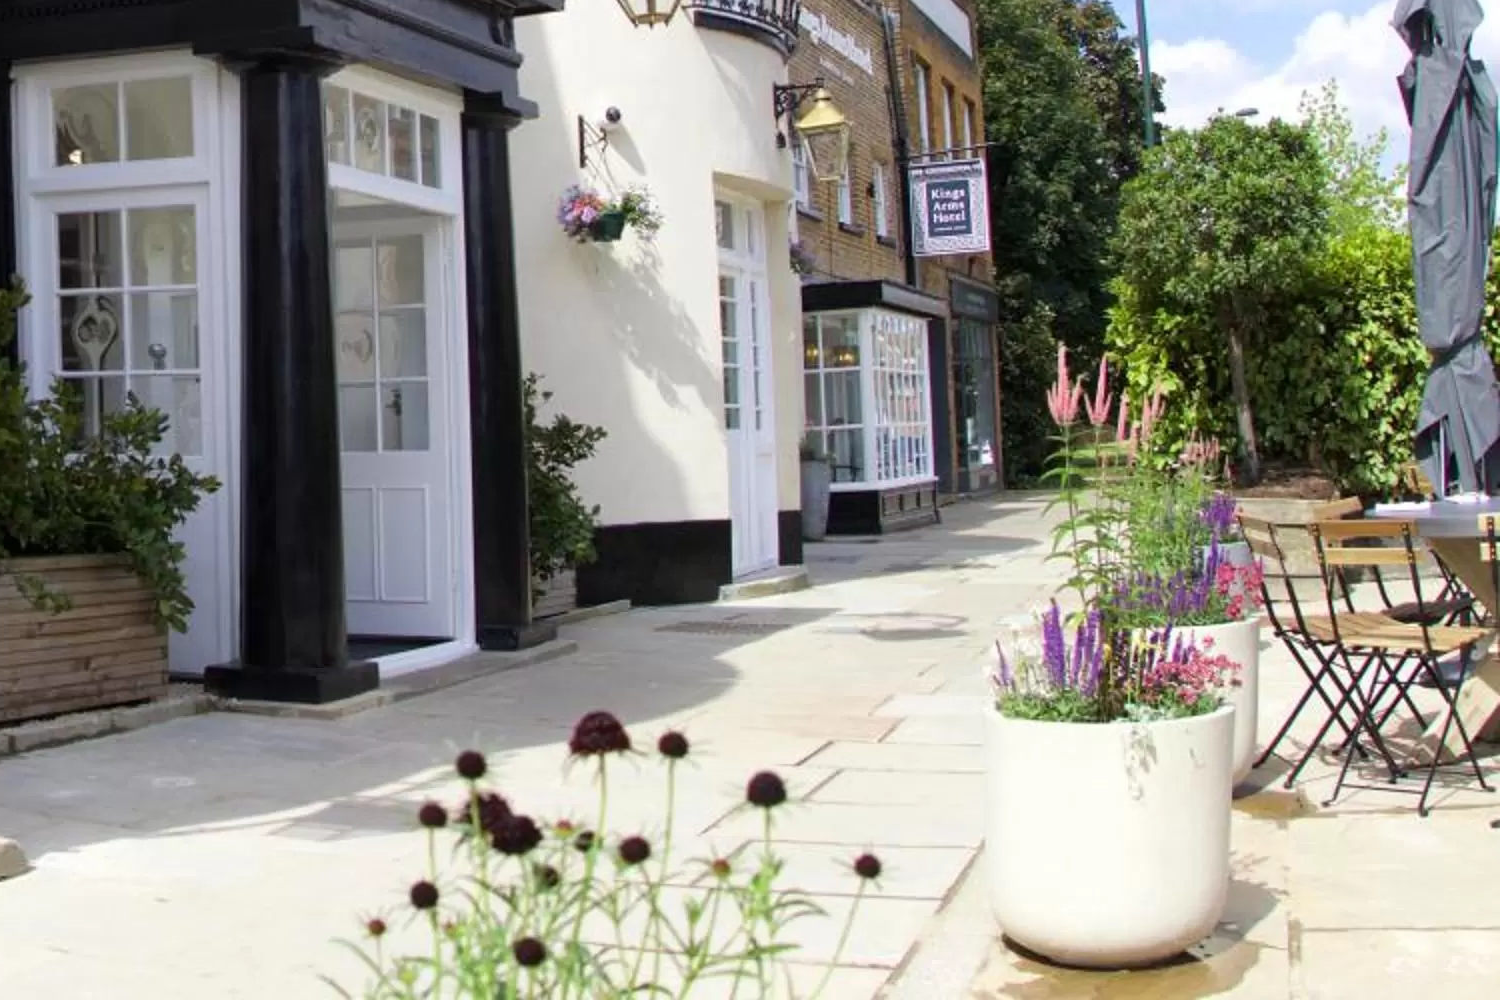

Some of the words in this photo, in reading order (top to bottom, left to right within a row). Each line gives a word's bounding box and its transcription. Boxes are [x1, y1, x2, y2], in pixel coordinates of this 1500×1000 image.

[931, 188, 966, 201] Kings
[933, 201, 965, 212] Arms
[933, 210, 967, 224] Hotel
